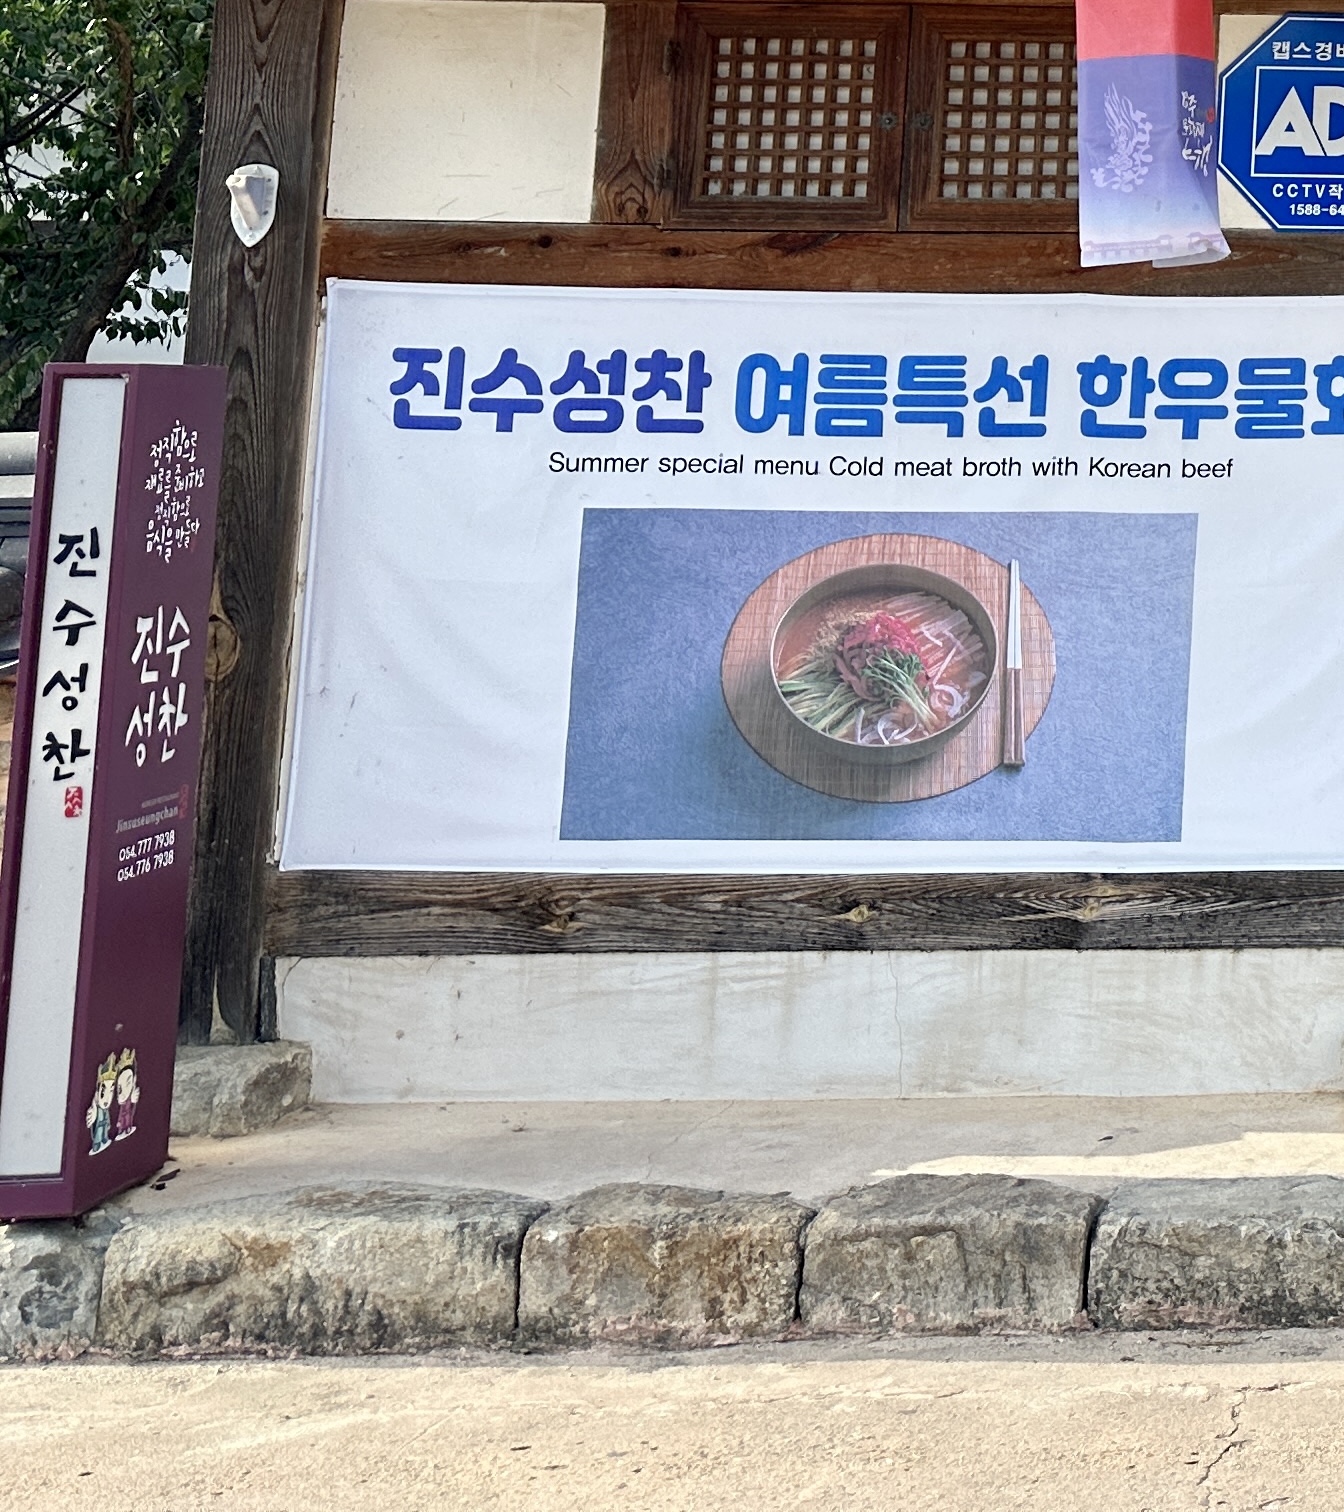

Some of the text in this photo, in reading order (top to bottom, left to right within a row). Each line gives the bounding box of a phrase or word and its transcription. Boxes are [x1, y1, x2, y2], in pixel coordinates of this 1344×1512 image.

[389, 345, 713, 434] 진수성찬
[734, 351, 1050, 438] 여름특선
[149, 419, 198, 468] 정직함으로
[548, 451, 1234, 479] Summer special menu Cold meat broth with Korean beef
[42, 525, 101, 782] 진수성찬
[154, 829, 176, 851] 7938
[153, 849, 175, 870] 7938
